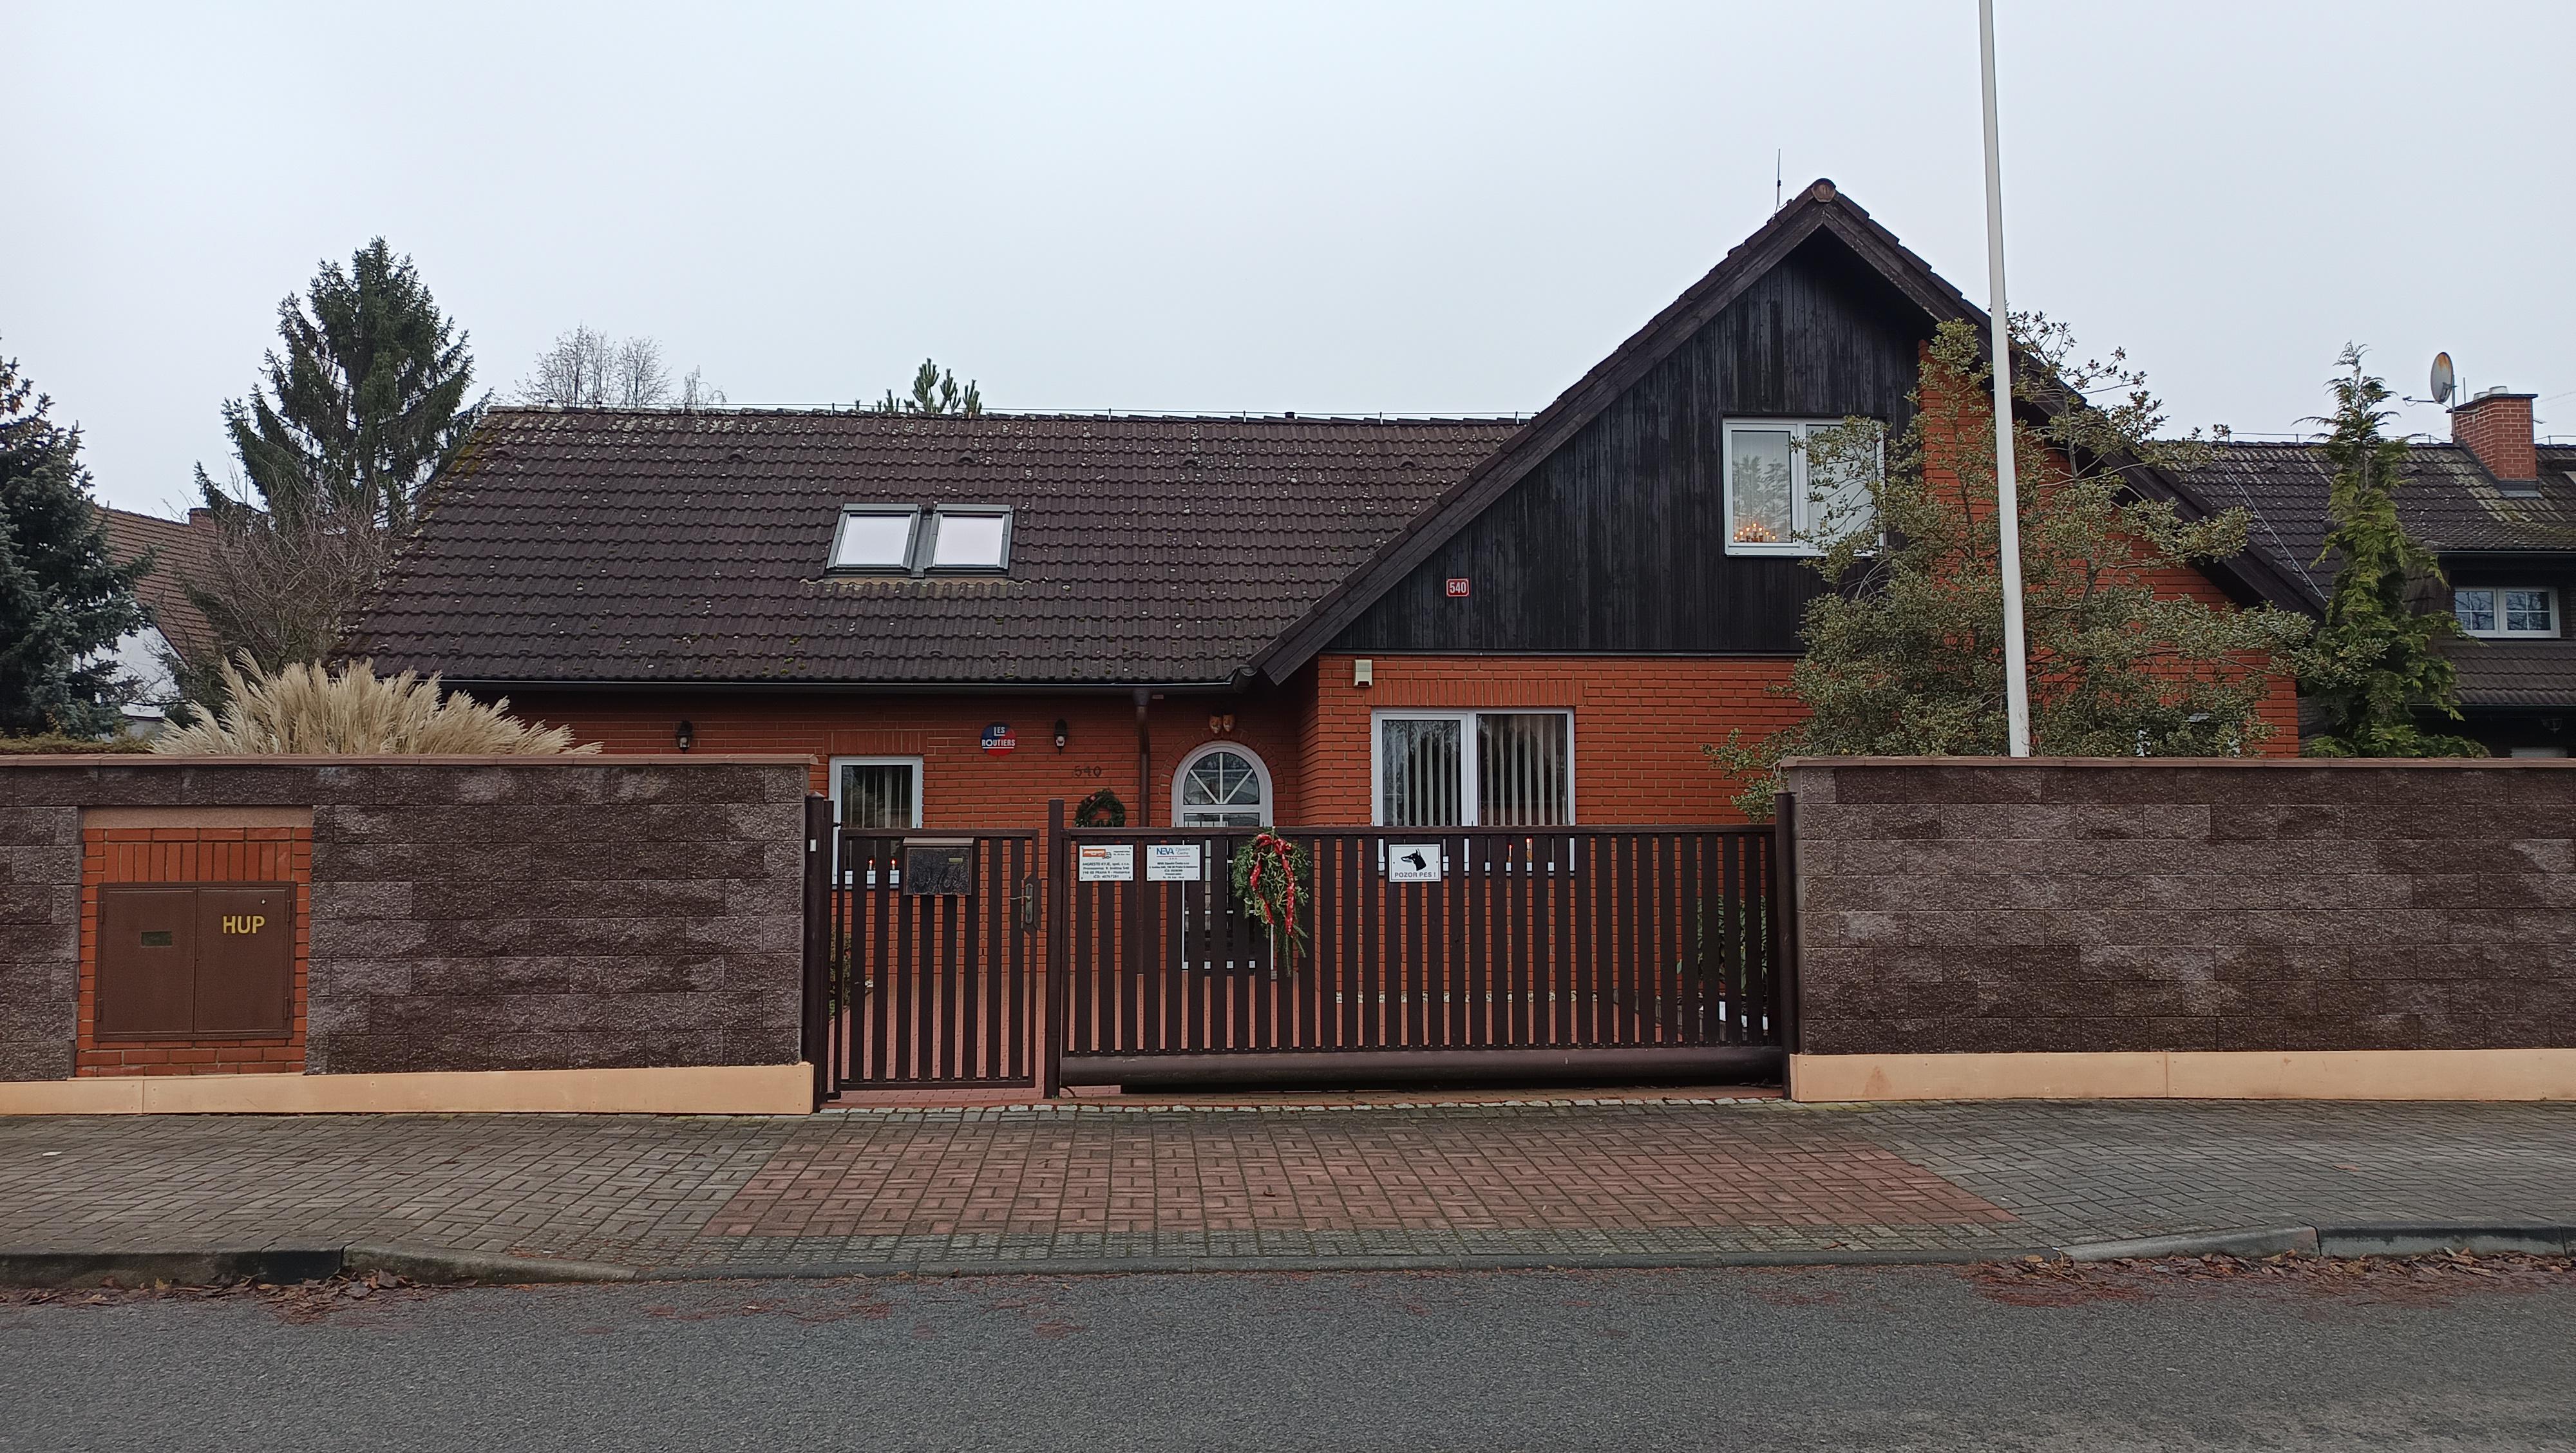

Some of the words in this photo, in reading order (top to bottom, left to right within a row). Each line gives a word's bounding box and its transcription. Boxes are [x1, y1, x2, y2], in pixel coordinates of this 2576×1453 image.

[1450, 582, 1466, 593] 540
[994, 726, 1005, 736] LES
[1075, 765, 1102, 777] 540
[223, 915, 265, 934] HUP
